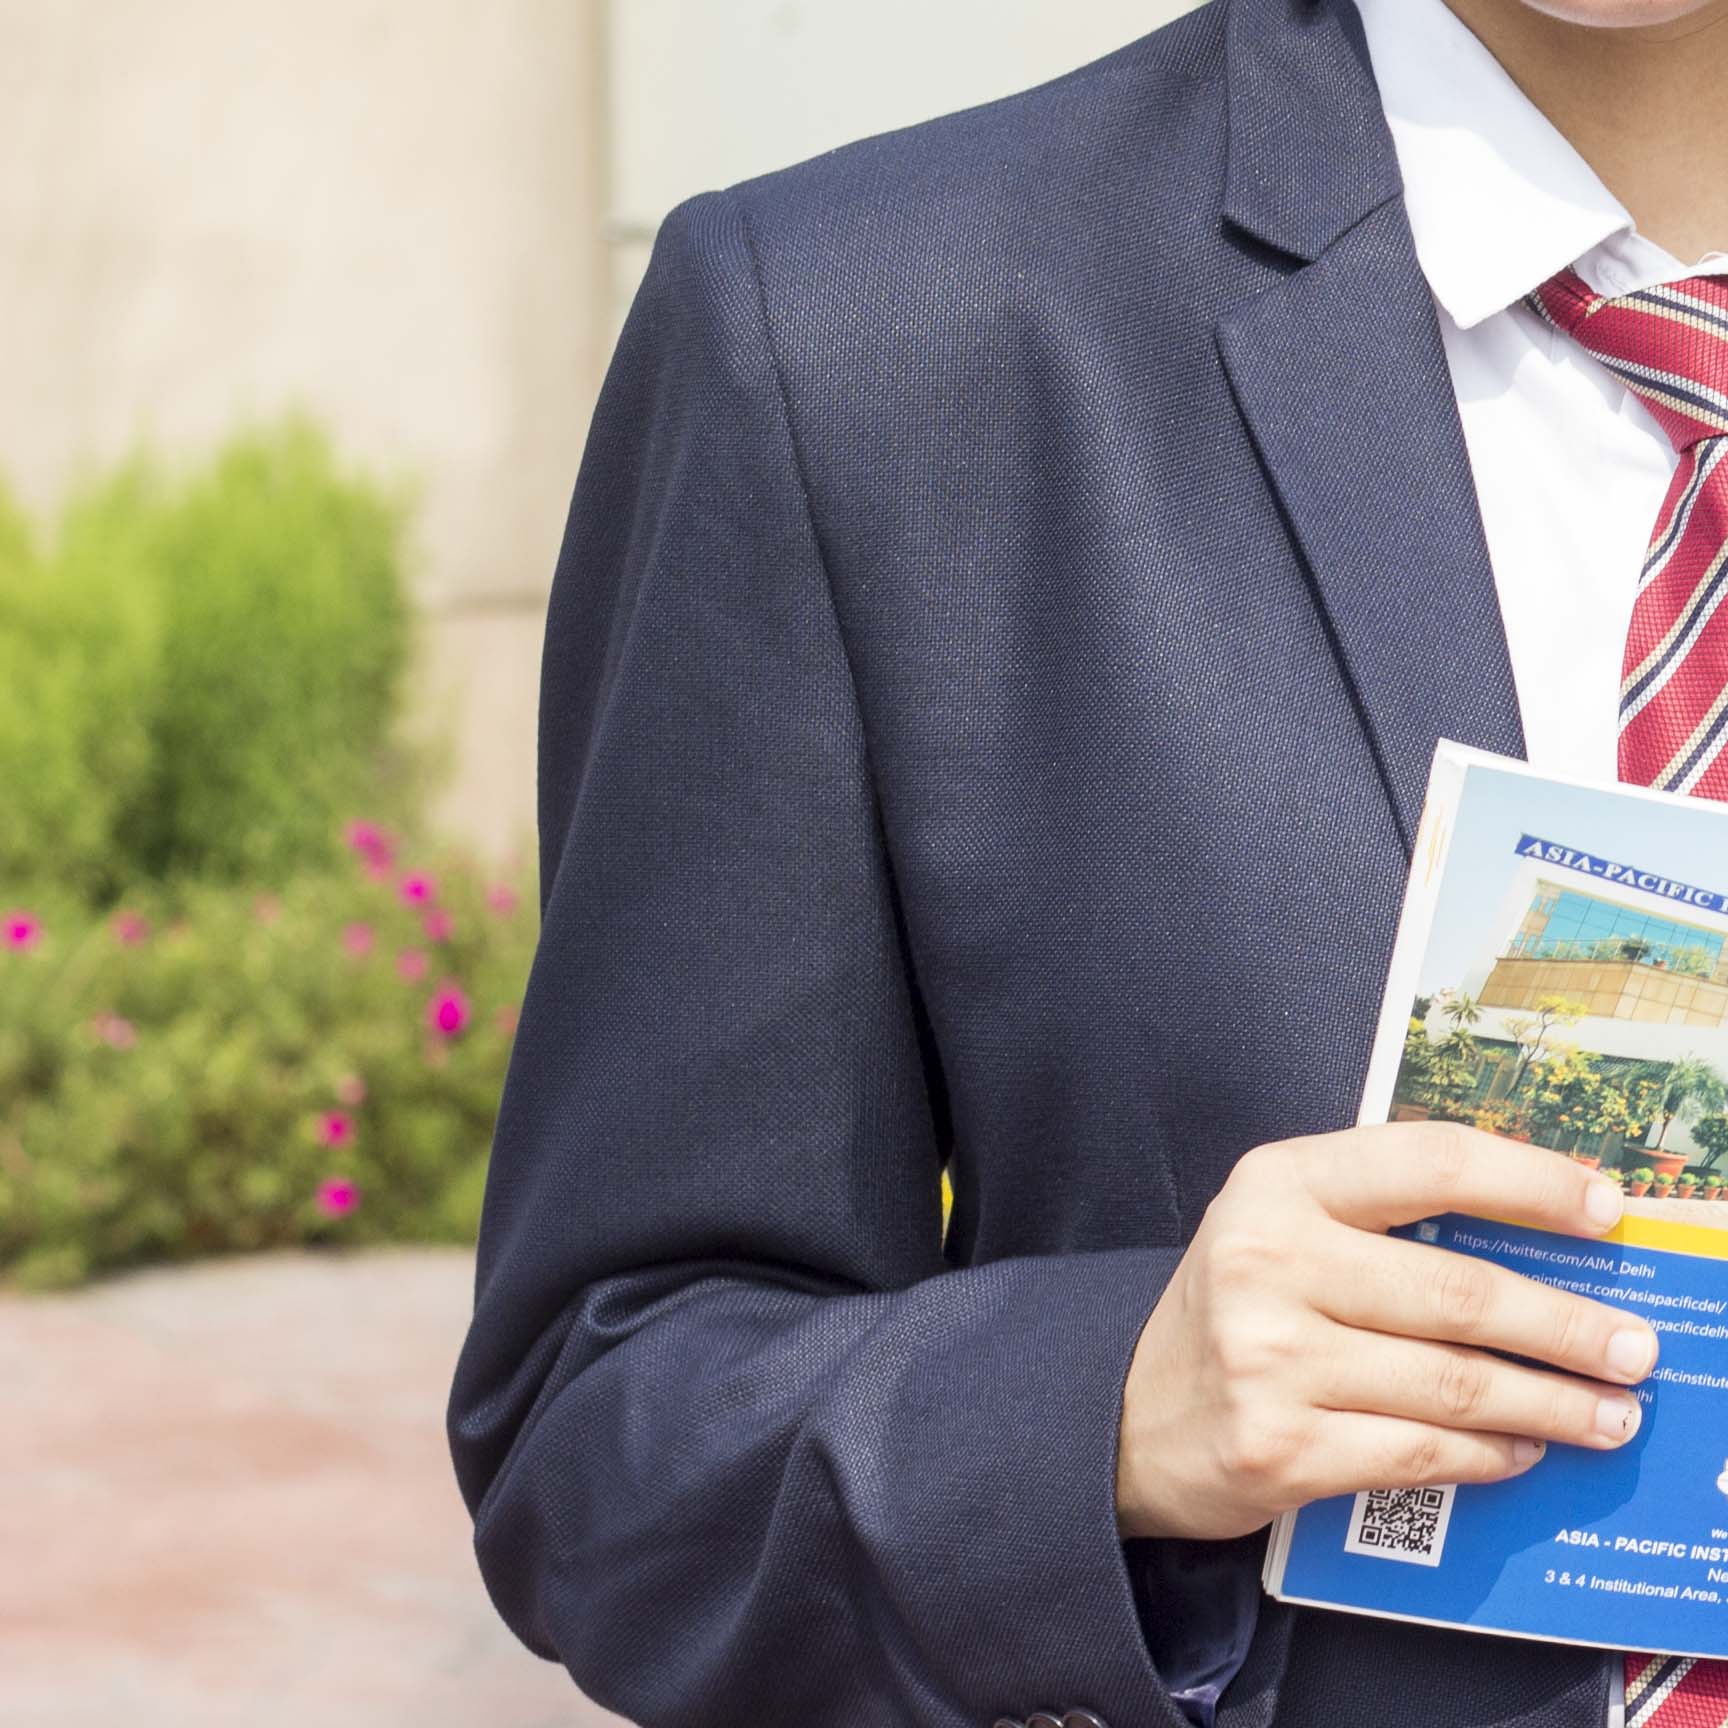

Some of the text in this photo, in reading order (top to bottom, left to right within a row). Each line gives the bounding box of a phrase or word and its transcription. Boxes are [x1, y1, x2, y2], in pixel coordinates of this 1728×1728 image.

[1523, 840, 1714, 907] ASIA-PACIFIC
[1453, 1230, 1657, 1280] https://twitter.com/AIM_Delhi
[1555, 1529, 1599, 1547] ASIA
[1615, 1536, 1686, 1558] PACIFIC
[1711, 1528, 1727, 1540] We
[1544, 1569, 1556, 1583] 3
[1559, 1571, 1571, 1585] &
[1575, 1574, 1586, 1588] 4
[1590, 1575, 1678, 1599] Institutional
[1680, 1587, 1722, 1604] Area,
